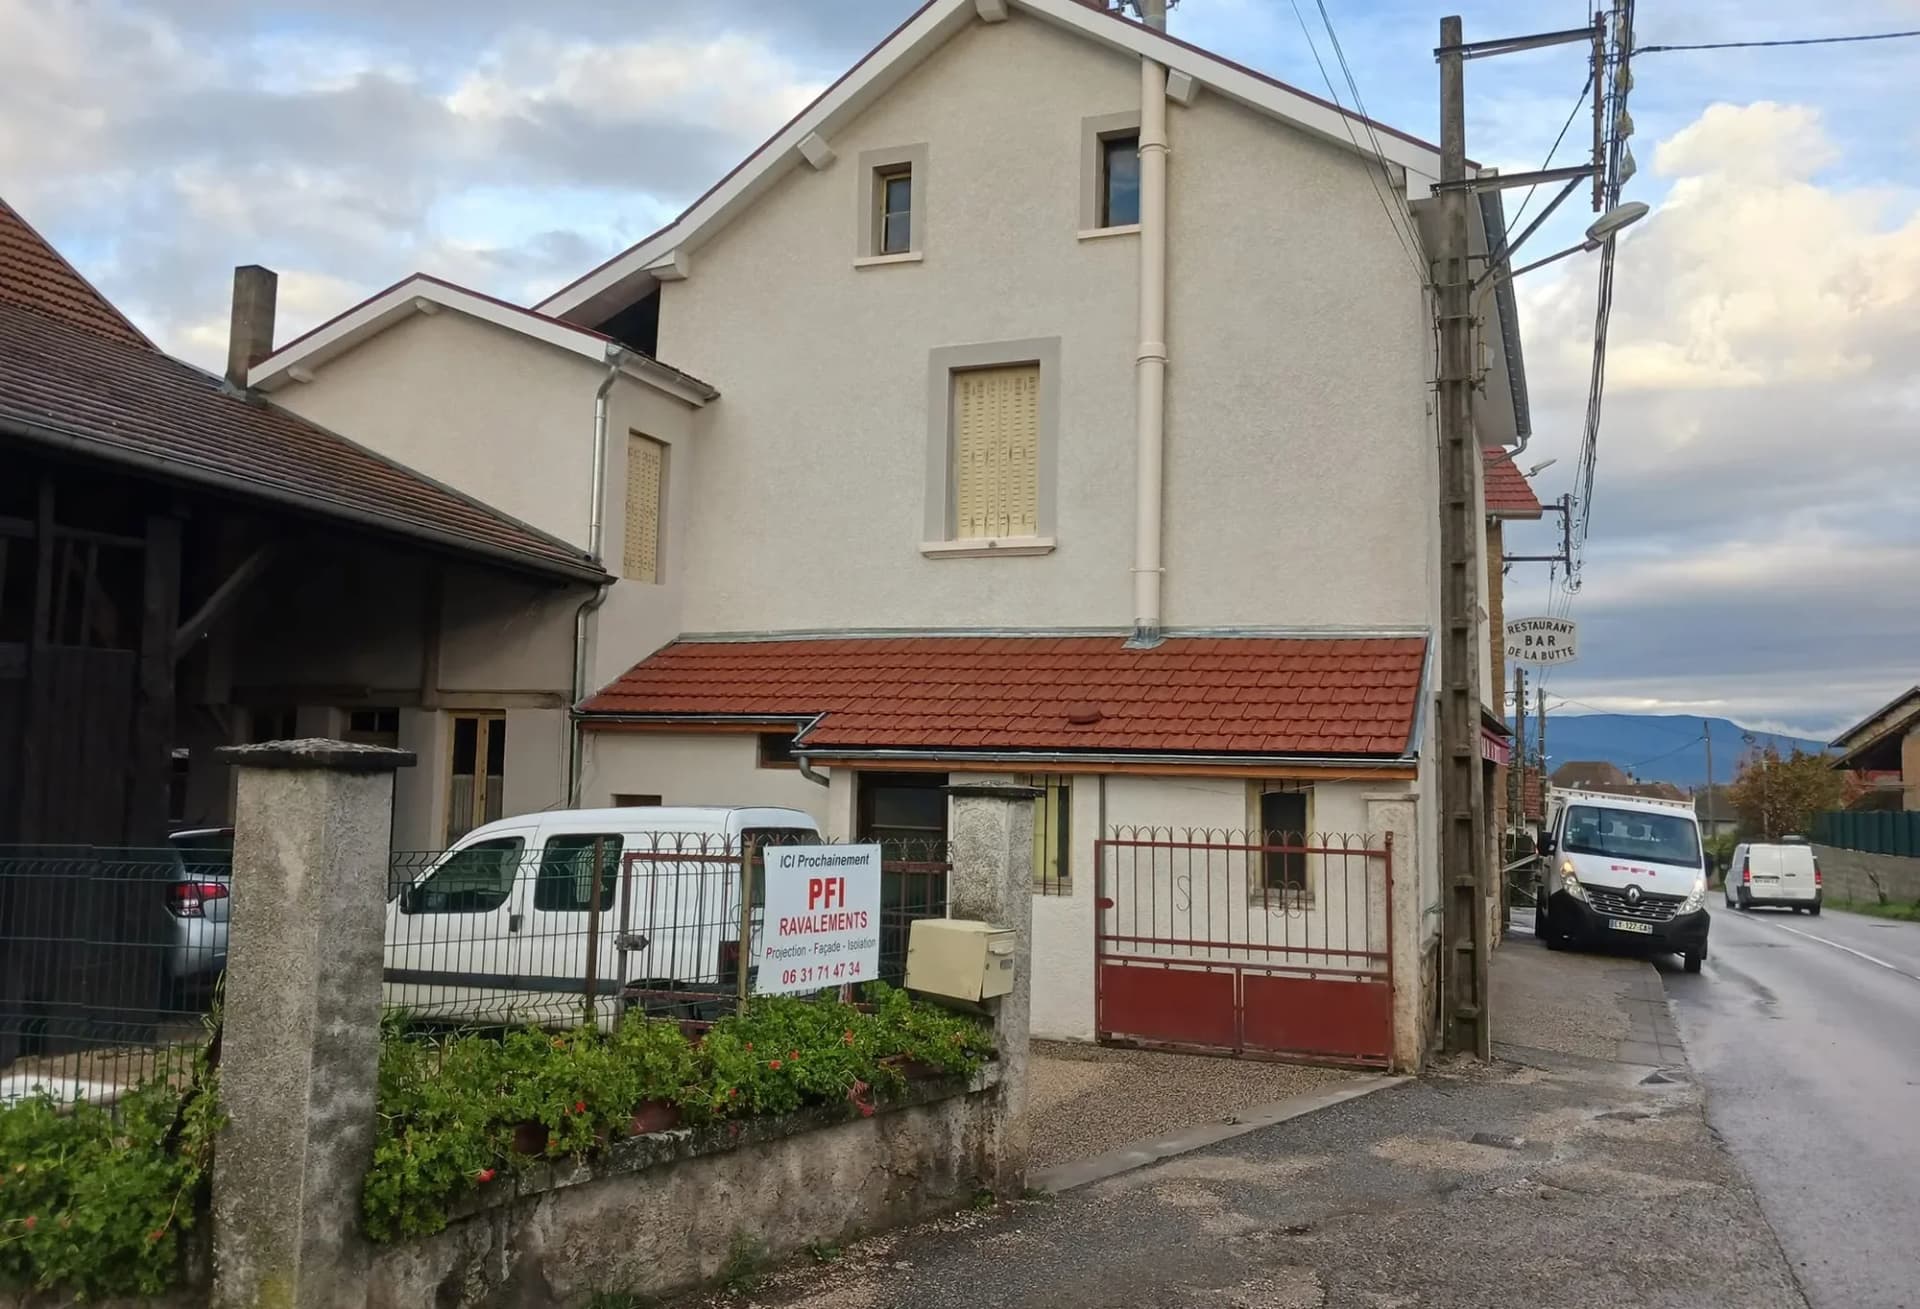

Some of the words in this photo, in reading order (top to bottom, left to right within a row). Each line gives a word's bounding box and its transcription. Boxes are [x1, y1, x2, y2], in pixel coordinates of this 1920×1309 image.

[1507, 620, 1574, 635] RESTAURANT
[1525, 635, 1556, 646] BAR
[1508, 646, 1521, 657] DE
[1524, 650, 1537, 660] LA
[1541, 646, 1575, 660] BUTTE
[780, 855, 795, 868] ICI
[797, 853, 869, 868] Prochainement
[808, 877, 845, 910] PFI
[779, 911, 868, 936] RAVALEMENTS
[766, 945, 807, 961] Projection
[814, 940, 841, 956] Façade
[848, 937, 876, 950] Isolation
[782, 969, 797, 985] 06
[800, 967, 813, 983] 31
[818, 965, 829, 981] 71
[833, 963, 846, 978] 47
[848, 961, 861, 976] 34
